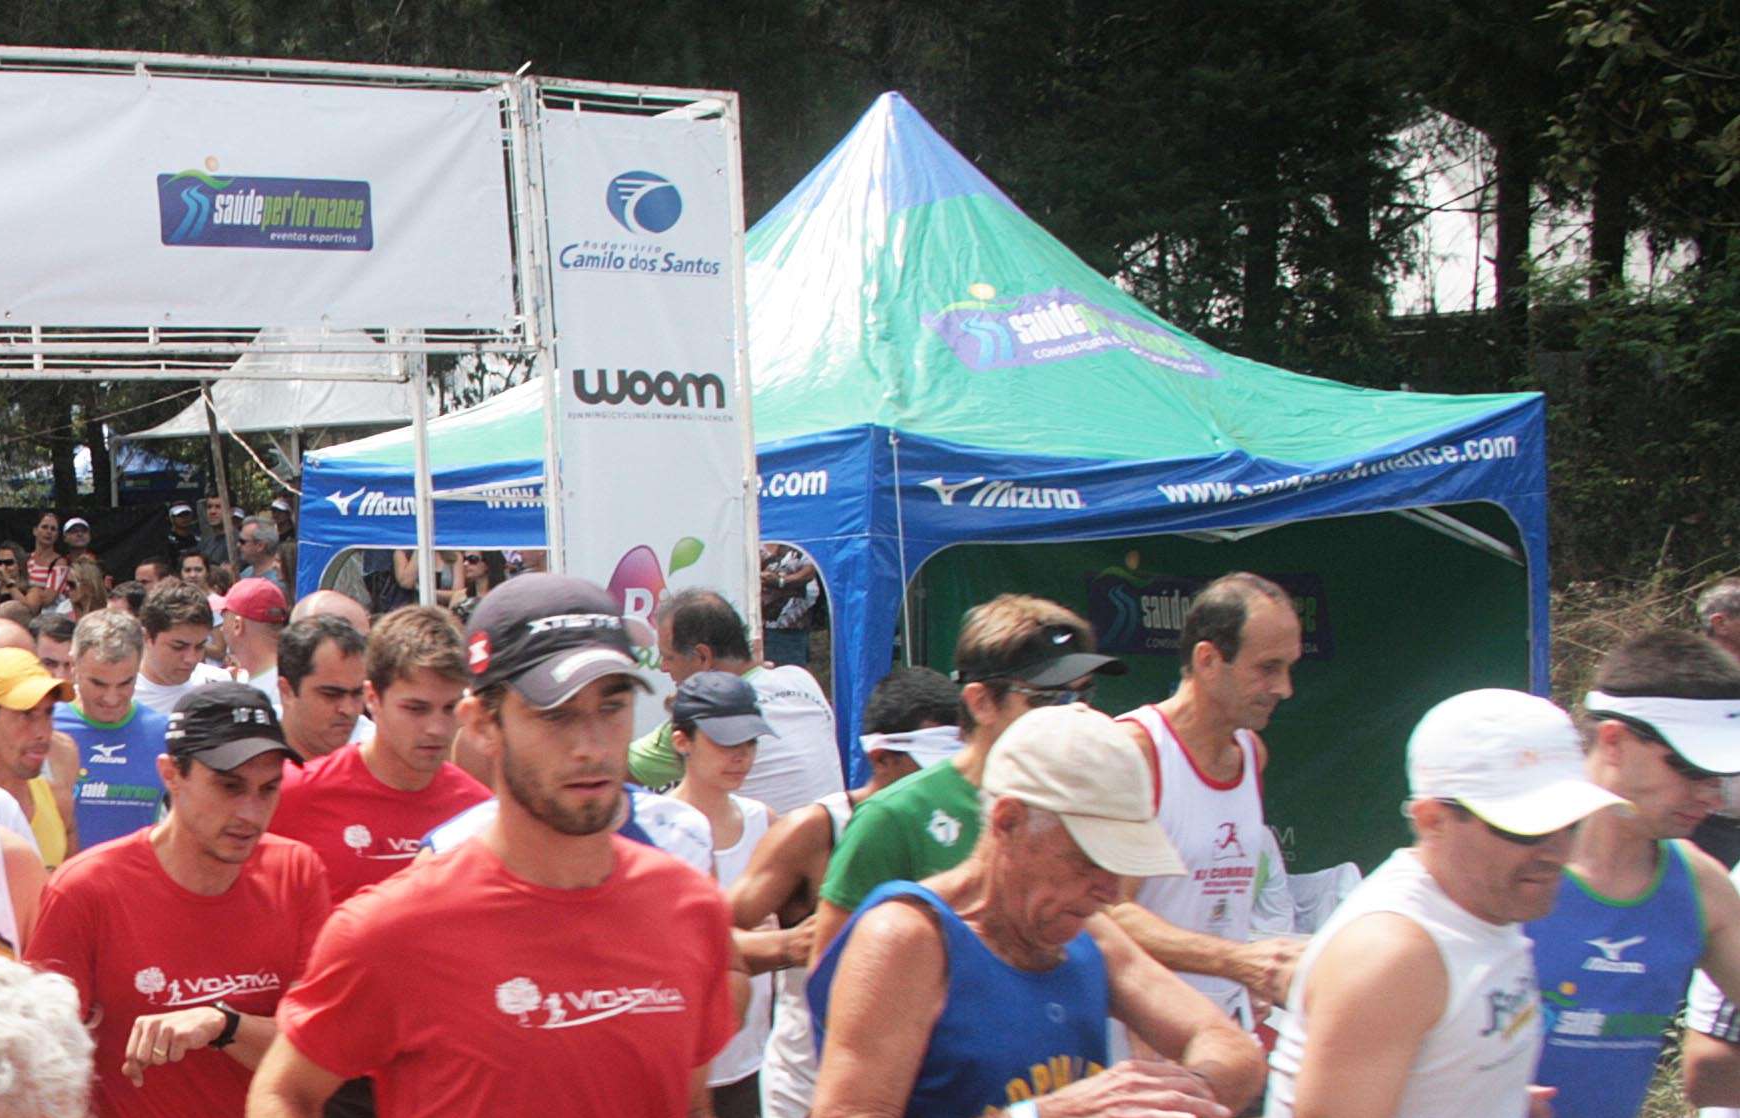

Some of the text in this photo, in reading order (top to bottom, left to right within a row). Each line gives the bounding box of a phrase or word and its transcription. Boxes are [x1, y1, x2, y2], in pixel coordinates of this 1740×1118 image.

[270, 232, 357, 244] eventos esportivos
[560, 243, 720, 276] Camilo dos Santos
[572, 369, 725, 408] woom
